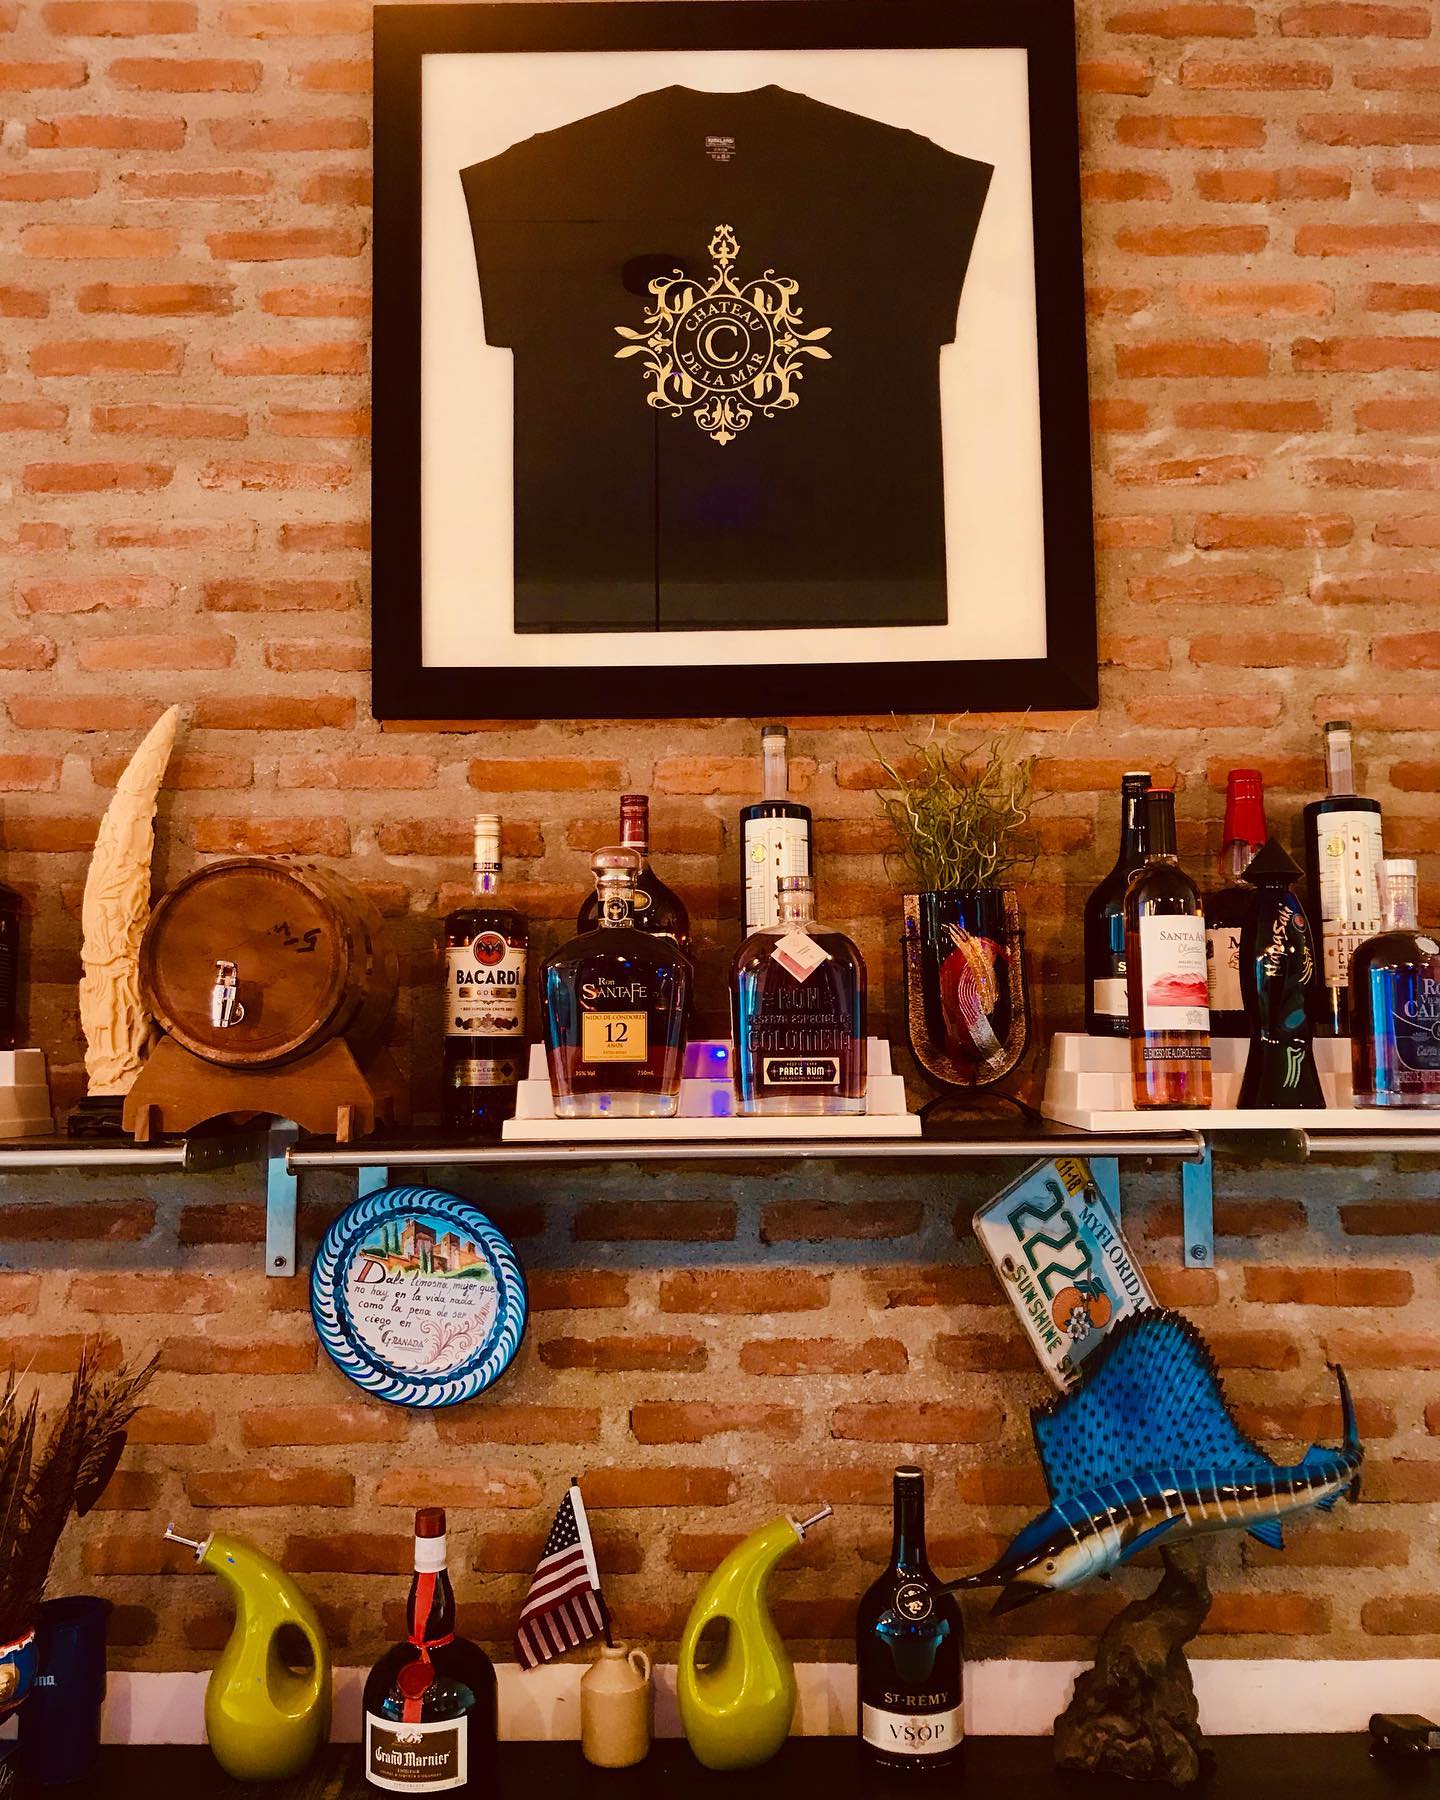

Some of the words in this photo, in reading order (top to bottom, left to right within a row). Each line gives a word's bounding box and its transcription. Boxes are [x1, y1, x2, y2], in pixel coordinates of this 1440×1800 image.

[685, 301, 764, 332] CHATEAU
[705, 325, 738, 363] C
[681, 351, 702, 374] DE
[701, 371, 725, 386] LA
[731, 353, 765, 385] MAR
[456, 966, 520, 985] BACARDÍ
[779, 987, 820, 1009] RON
[605, 1022, 628, 1043] 12
[747, 1029, 852, 1051] COLOMBIA
[779, 1067, 803, 1075] PARCE
[806, 1067, 825, 1075] RUM
[353, 1259, 405, 1285] Dale
[480, 1285, 496, 1300] que
[354, 1285, 365, 1294] no
[371, 1285, 389, 1301] hay
[395, 1291, 407, 1299] en
[412, 1288, 421, 1301] la
[425, 1291, 446, 1303] vida
[450, 1294, 476, 1306] nada
[358, 1300, 384, 1311] como
[391, 1300, 403, 1313] la
[408, 1306, 431, 1319] pena
[437, 1305, 449, 1318] de
[1013, 1264, 1062, 1354] SUNSHINE
[364, 1314, 392, 1331] ciego
[399, 1320, 412, 1328] en
[889, 1723, 945, 1742] VSOP
[375, 1746, 402, 1766] Grand
[403, 1752, 450, 1767] Marnier
